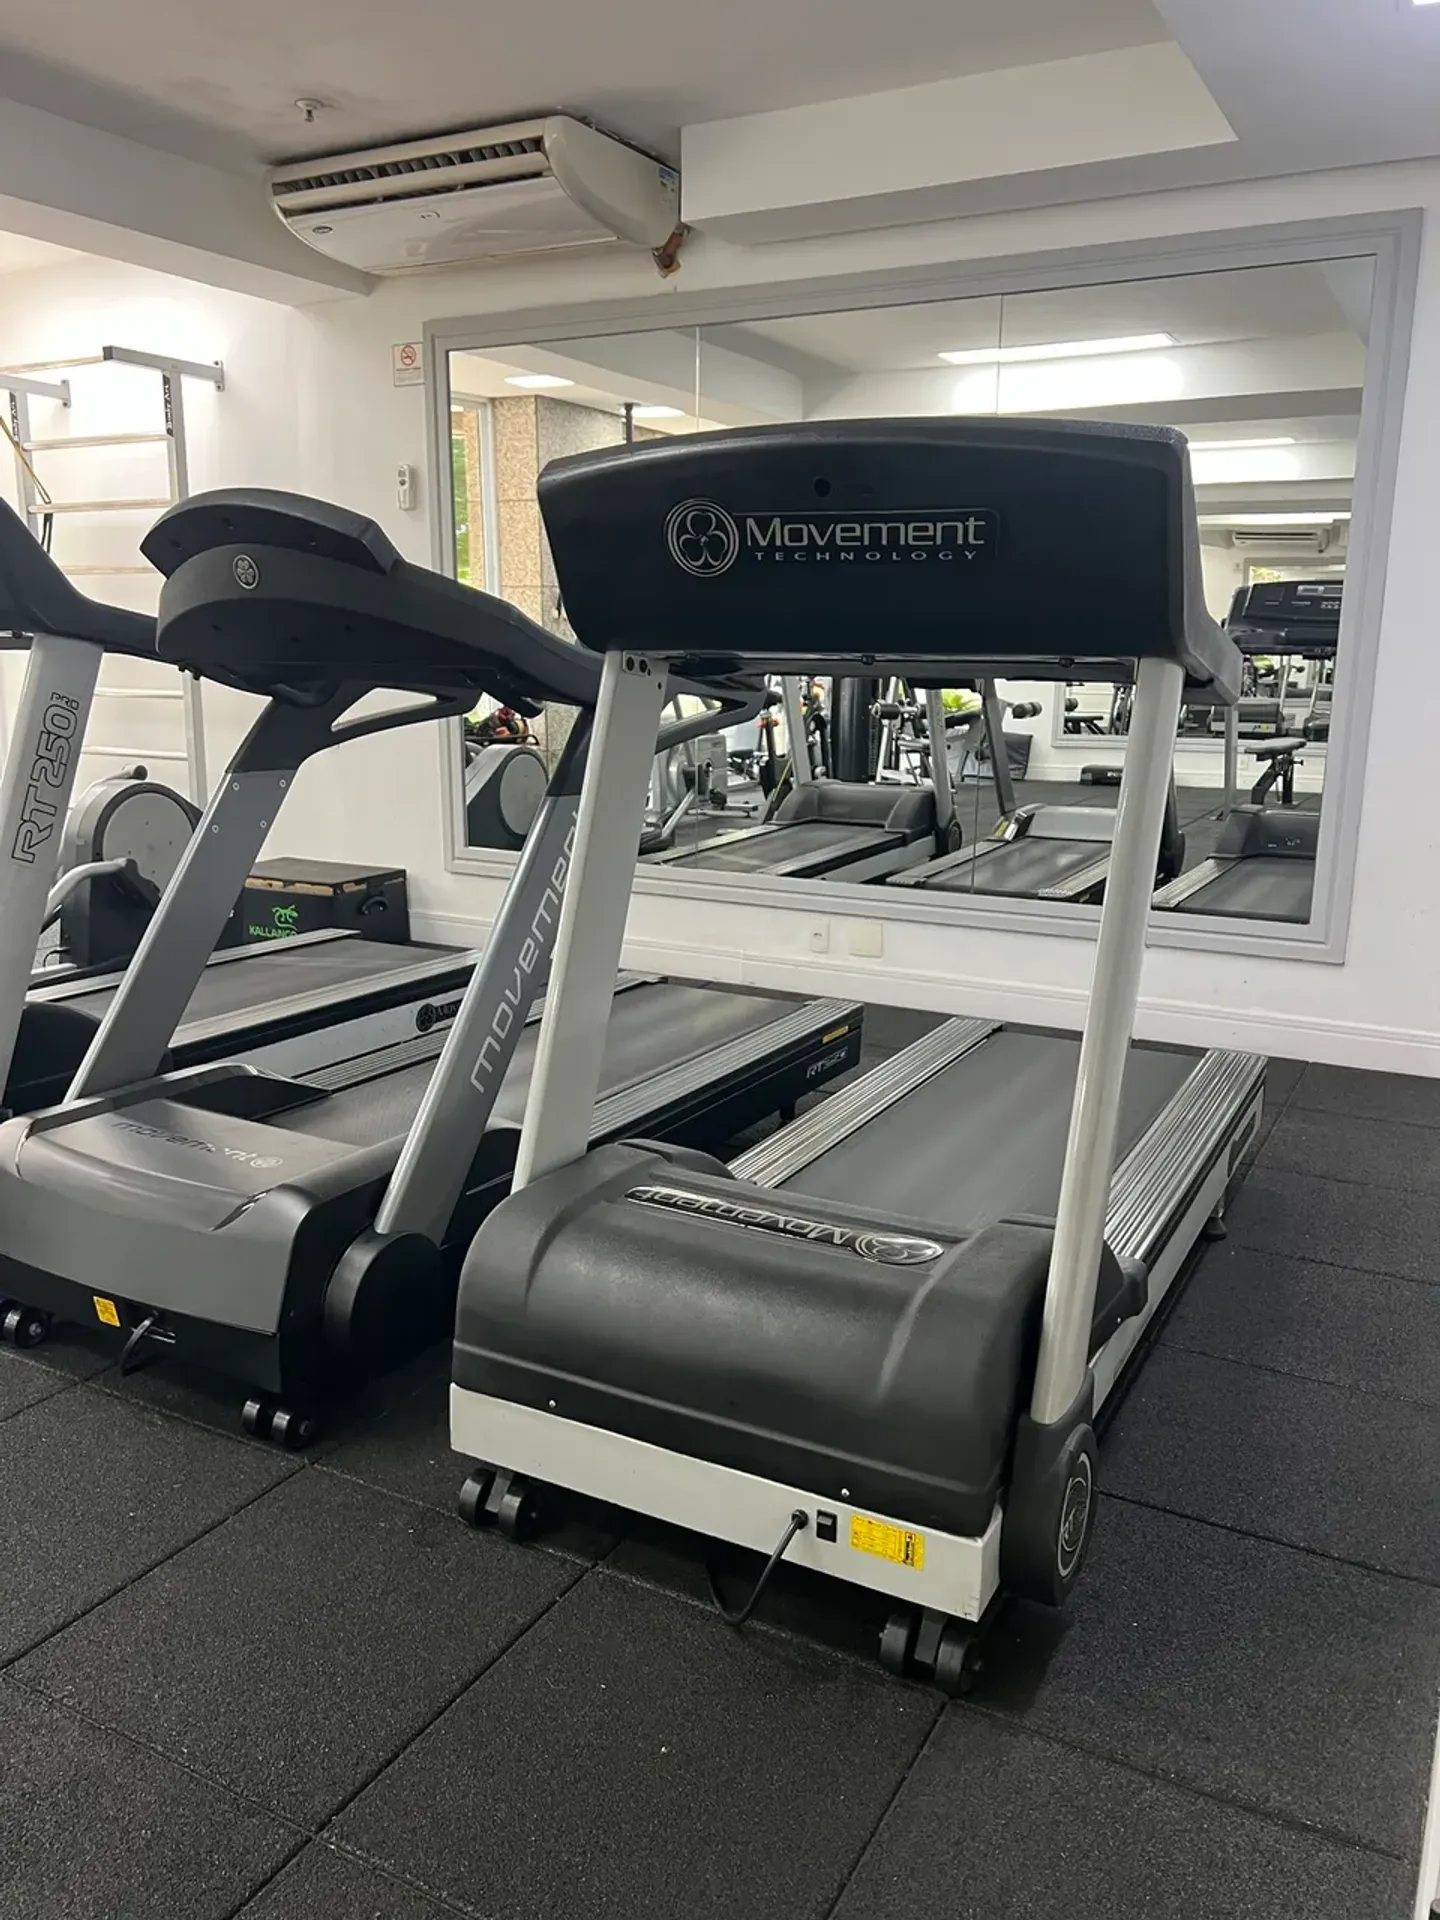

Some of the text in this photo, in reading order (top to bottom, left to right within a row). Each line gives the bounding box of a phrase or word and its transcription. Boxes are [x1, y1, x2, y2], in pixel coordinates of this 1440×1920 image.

[745, 517, 986, 546] Movement
[754, 551, 976, 561] TECHNOLOGY
[51, 692, 79, 710] PRO
[639, 1189, 852, 1246] Movement
